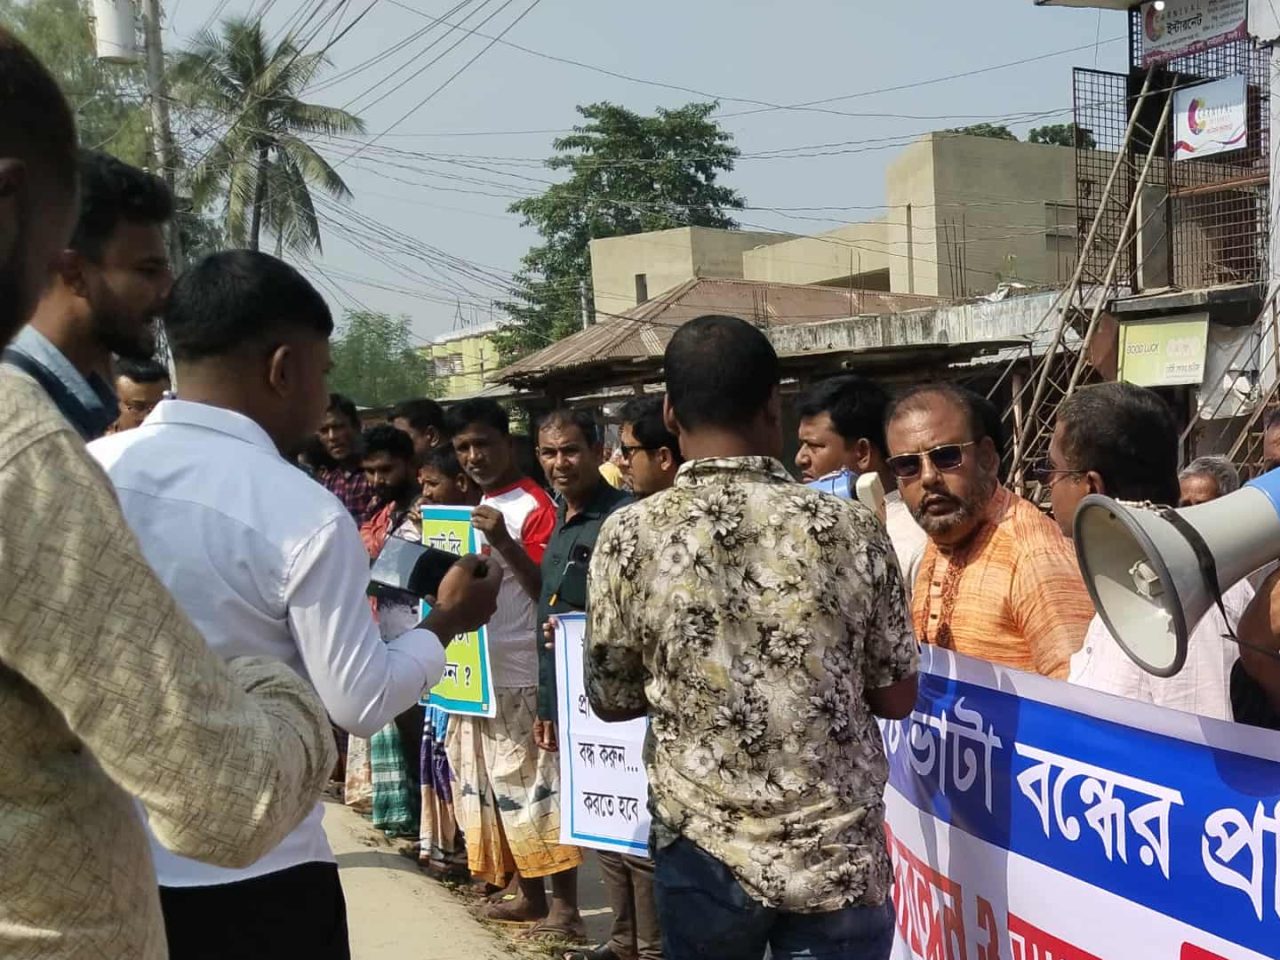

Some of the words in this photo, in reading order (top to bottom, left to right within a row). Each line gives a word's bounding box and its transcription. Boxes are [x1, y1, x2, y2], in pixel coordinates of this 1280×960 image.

[578, 742, 595, 769] বন্ধ
[583, 791, 614, 817] করতে
[617, 796, 639, 824] হবে
[1015, 742, 1184, 880] বন্ধের
